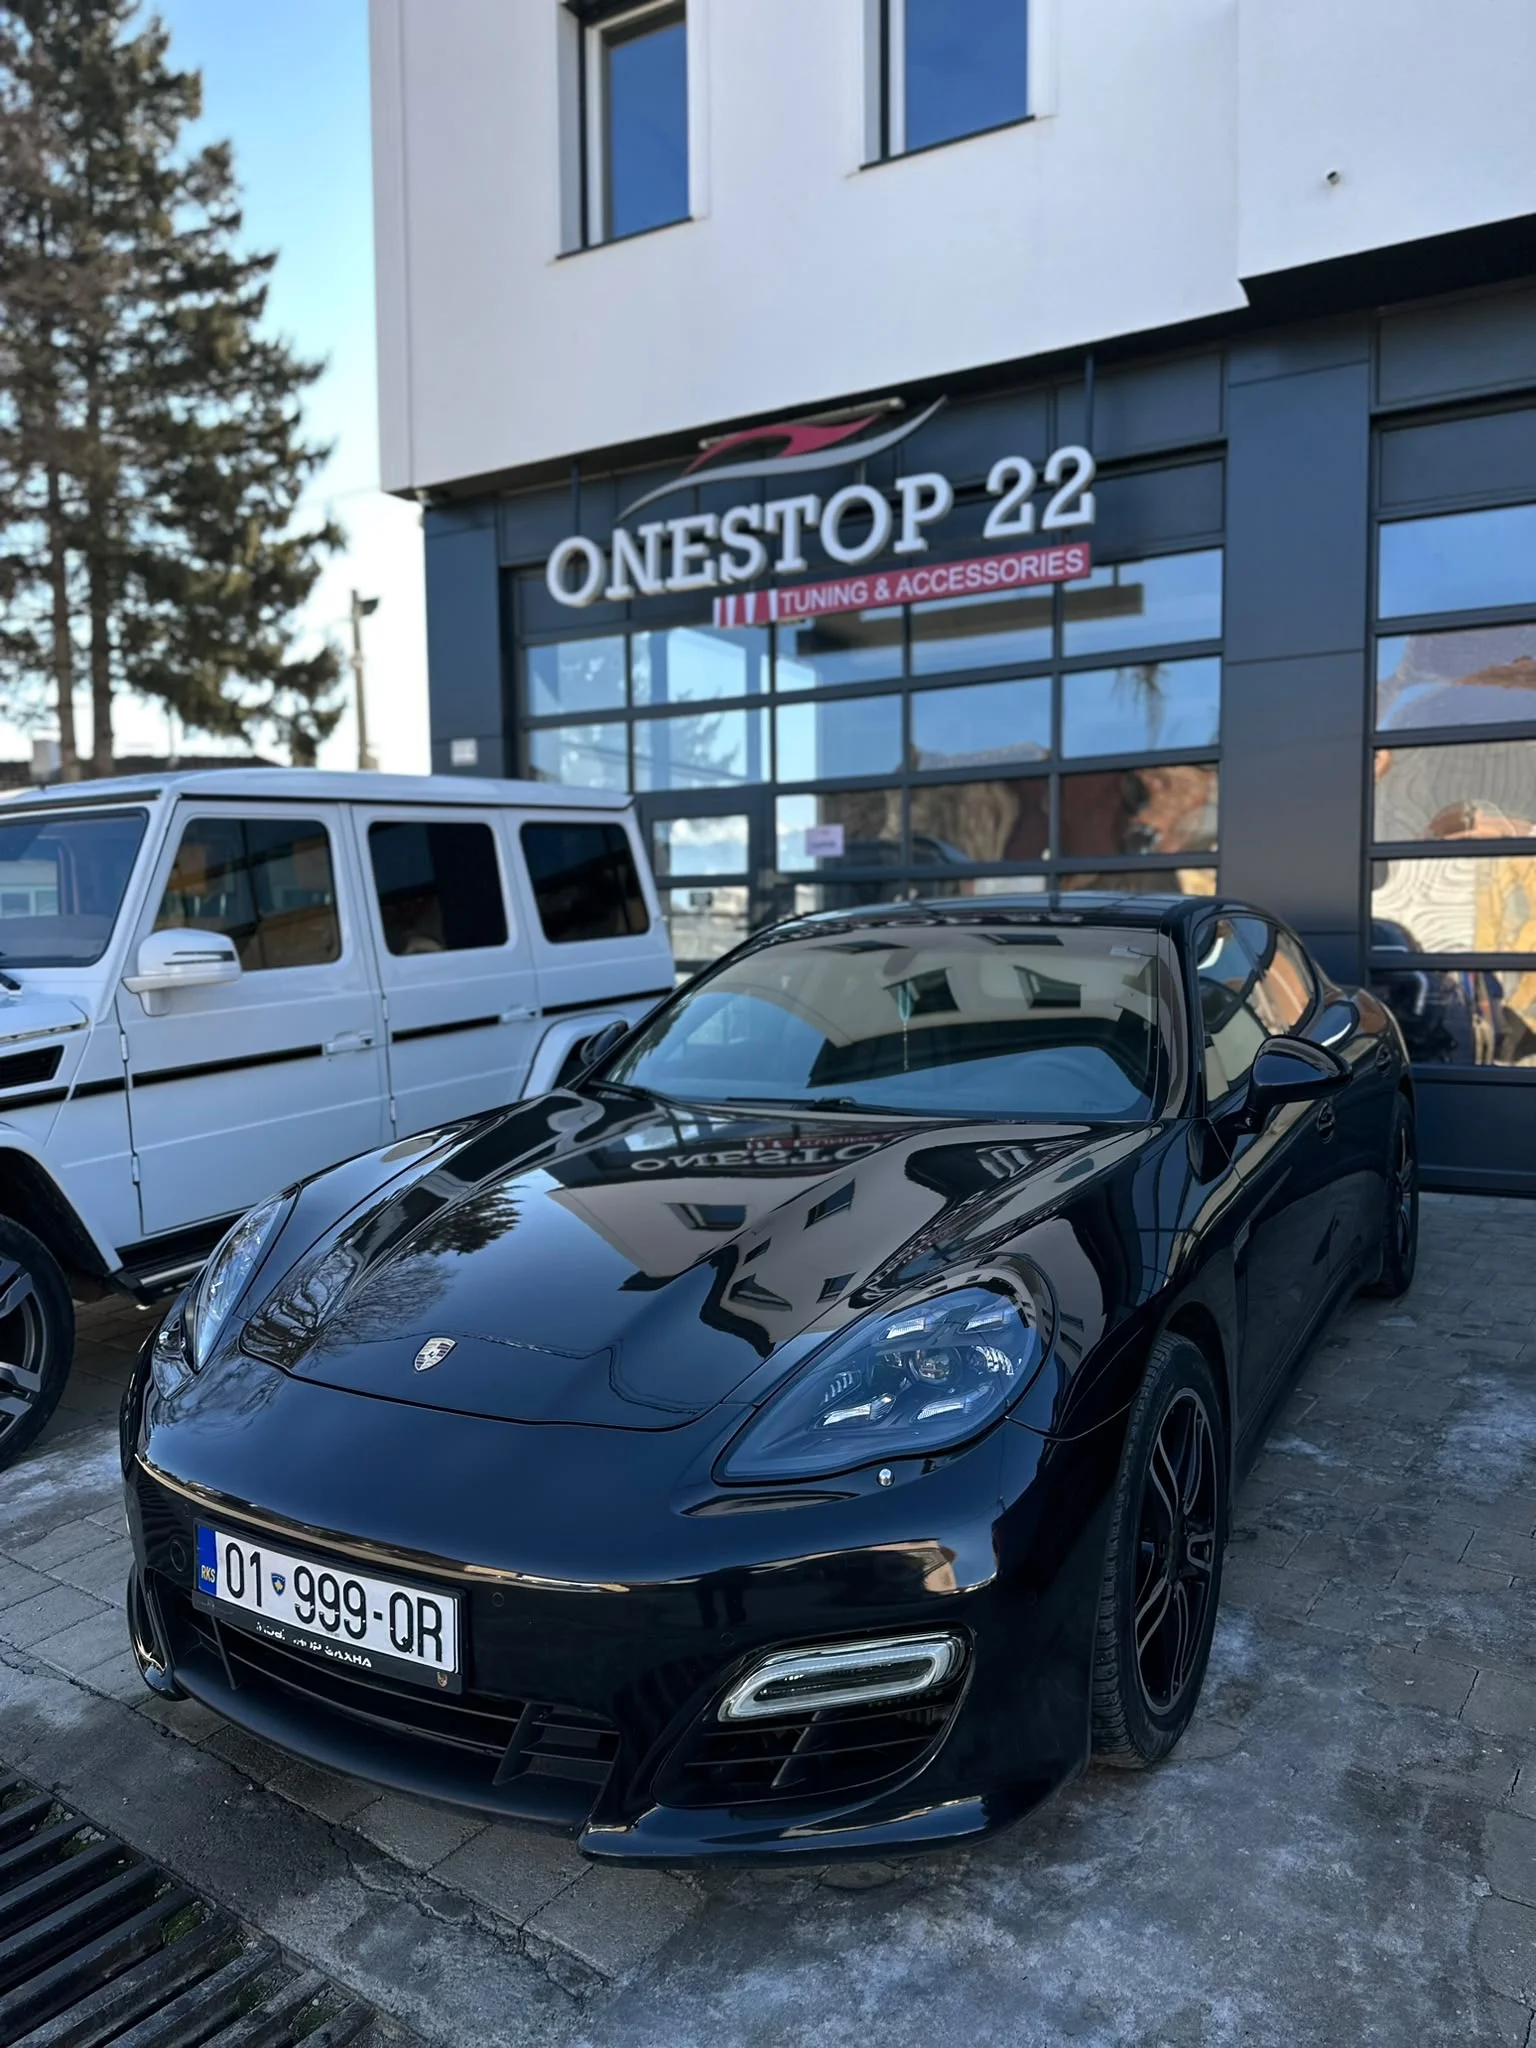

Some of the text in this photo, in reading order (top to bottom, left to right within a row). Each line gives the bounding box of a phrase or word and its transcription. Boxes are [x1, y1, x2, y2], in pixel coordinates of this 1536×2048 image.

[546, 445, 1096, 607] ONESTOP 22
[780, 548, 1084, 614] TUNING & ACCESSORIES
[201, 1564, 216, 1584] RKS
[225, 1541, 443, 1663] 01 999-QR
